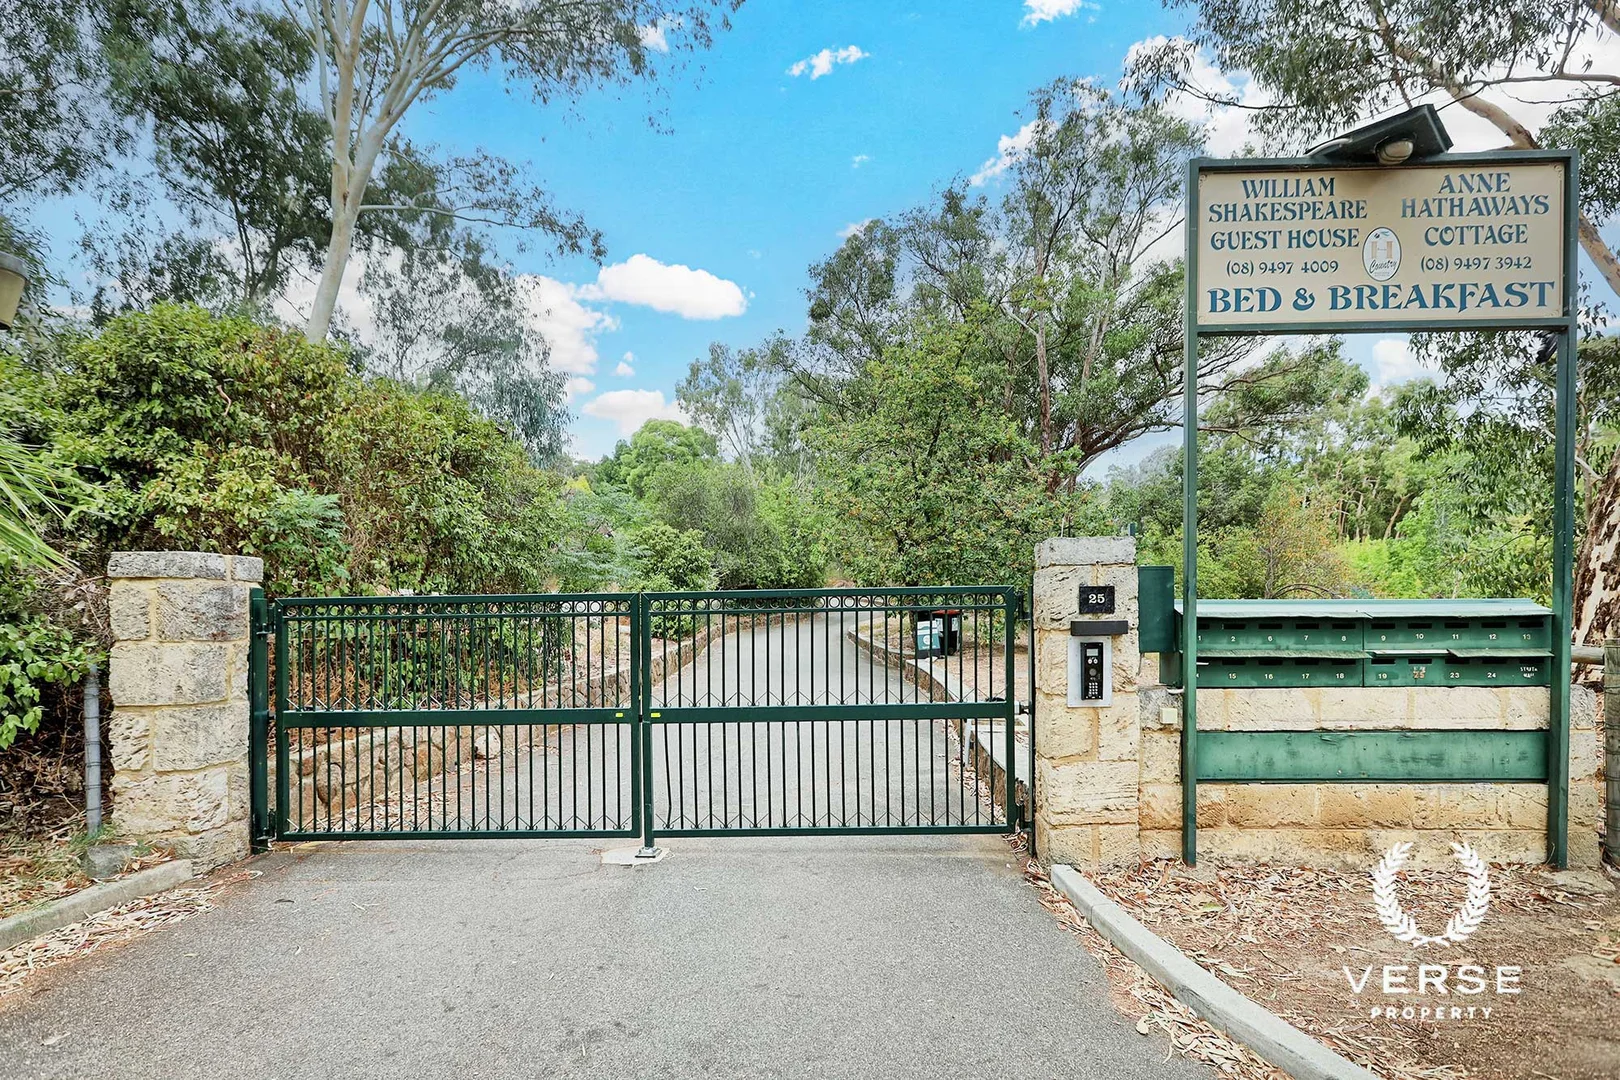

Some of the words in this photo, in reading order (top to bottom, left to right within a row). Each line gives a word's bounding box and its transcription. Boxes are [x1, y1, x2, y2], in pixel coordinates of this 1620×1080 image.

[1241, 177, 1336, 199] WILLIAM
[1438, 172, 1511, 194] ANNE
[1208, 200, 1368, 222] SHAKESPEARE
[1401, 195, 1549, 218] HATHAWAYS
[1211, 230, 1282, 250] GUEST
[1288, 228, 1360, 249] HOUSE
[1424, 224, 1528, 246] COTTAGE
[1226, 260, 1254, 277] (08)
[1259, 261, 1294, 275] 9497
[1301, 260, 1339, 273] 4009
[1420, 256, 1449, 273] (08)
[1453, 257, 1491, 270] 9497
[1495, 256, 1532, 269] 3942
[1207, 287, 1282, 313] BED
[1292, 287, 1316, 311] &
[1327, 281, 1555, 313] BREAKFAST
[1088, 593, 1105, 604] 25
